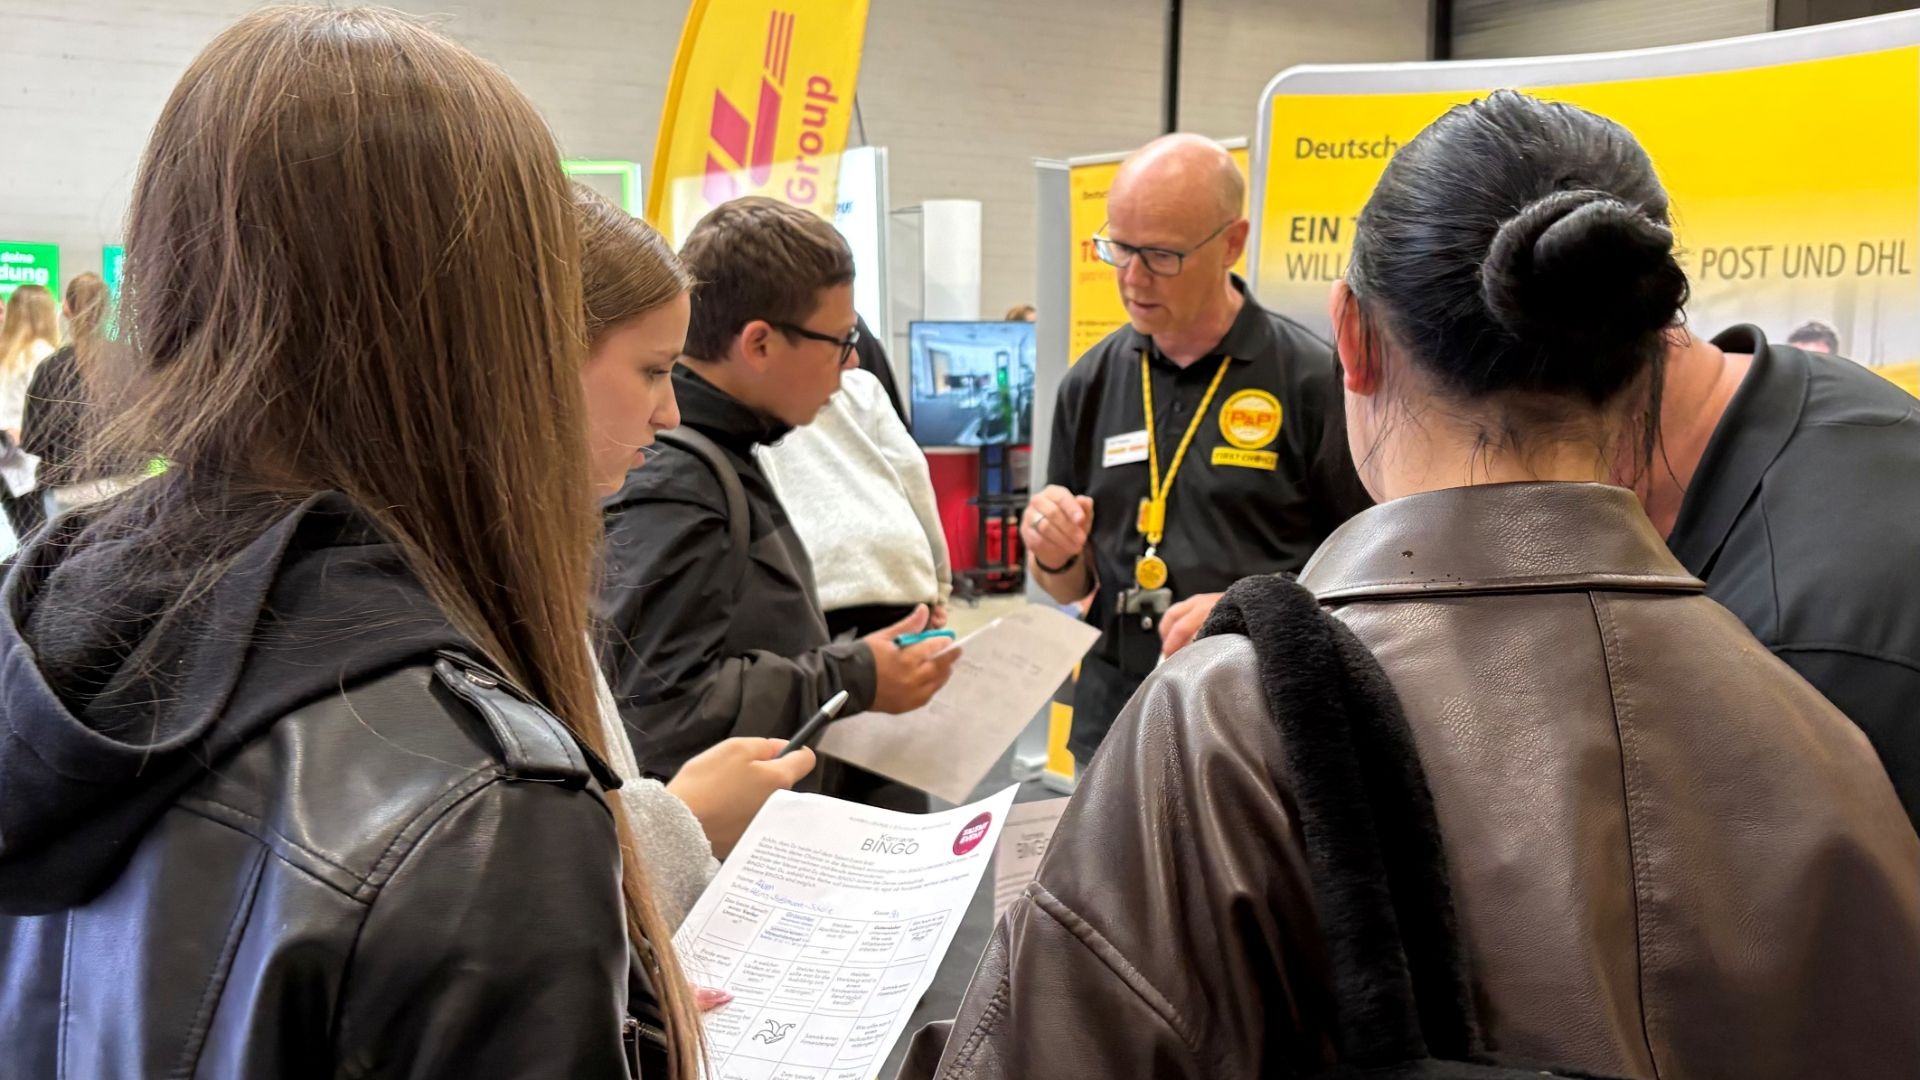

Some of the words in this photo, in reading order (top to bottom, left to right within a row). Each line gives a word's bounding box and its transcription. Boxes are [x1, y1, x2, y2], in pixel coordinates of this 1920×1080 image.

[786, 76, 839, 204] Group
[1296, 135, 1398, 159] Deutsch
[1290, 217, 1340, 242] EIN
[1286, 253, 1344, 281] WILL
[1700, 245, 1773, 279] POST
[1783, 244, 1846, 278] UND
[1856, 240, 1912, 275] DHL
[1231, 410, 1272, 428] P&P
[861, 837, 920, 855] BINGO
[880, 833, 915, 843] Karriere
